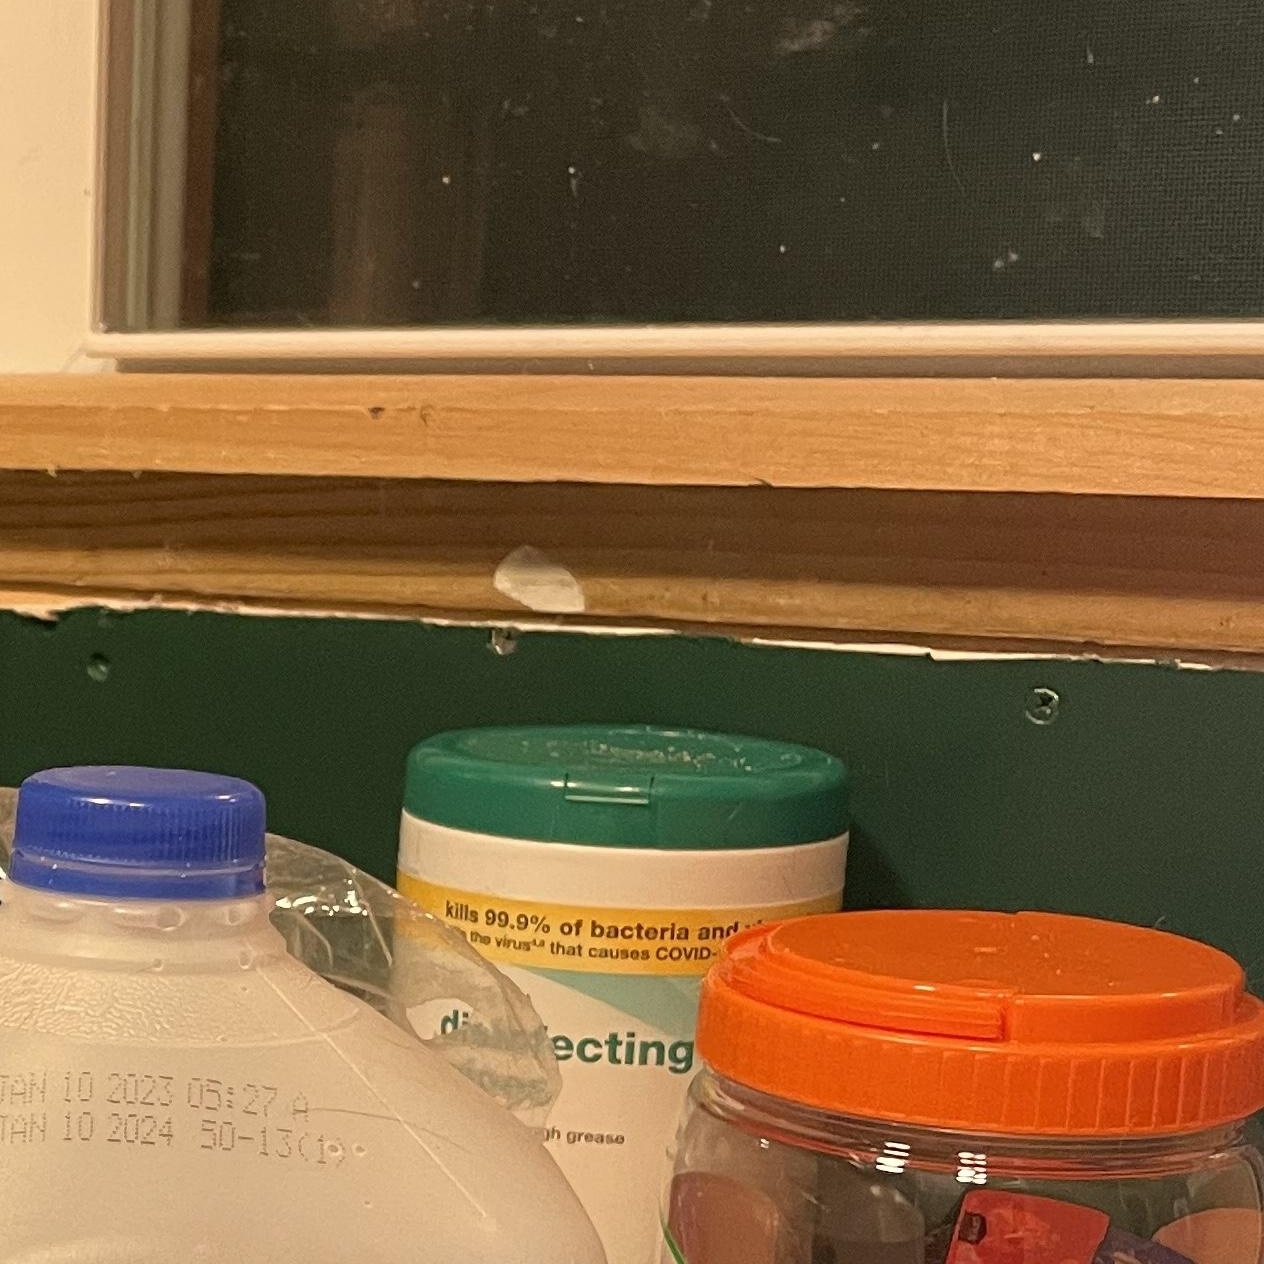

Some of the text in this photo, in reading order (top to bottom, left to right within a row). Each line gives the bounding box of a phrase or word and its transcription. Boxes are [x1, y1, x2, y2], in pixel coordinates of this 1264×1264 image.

[445, 899, 479, 923] kills
[484, 908, 551, 935] 99.9%
[559, 918, 583, 937] of
[590, 919, 689, 941] bacteria
[697, 921, 739, 940] and
[470, 930, 491, 946] the
[550, 941, 583, 958] that
[588, 946, 651, 961] causes
[64, 1070, 93, 1103] 10
[106, 1072, 175, 1107] 2023
[63, 1110, 94, 1142] 10
[106, 1113, 175, 1148] 2024
[566, 1131, 625, 1145] grease
